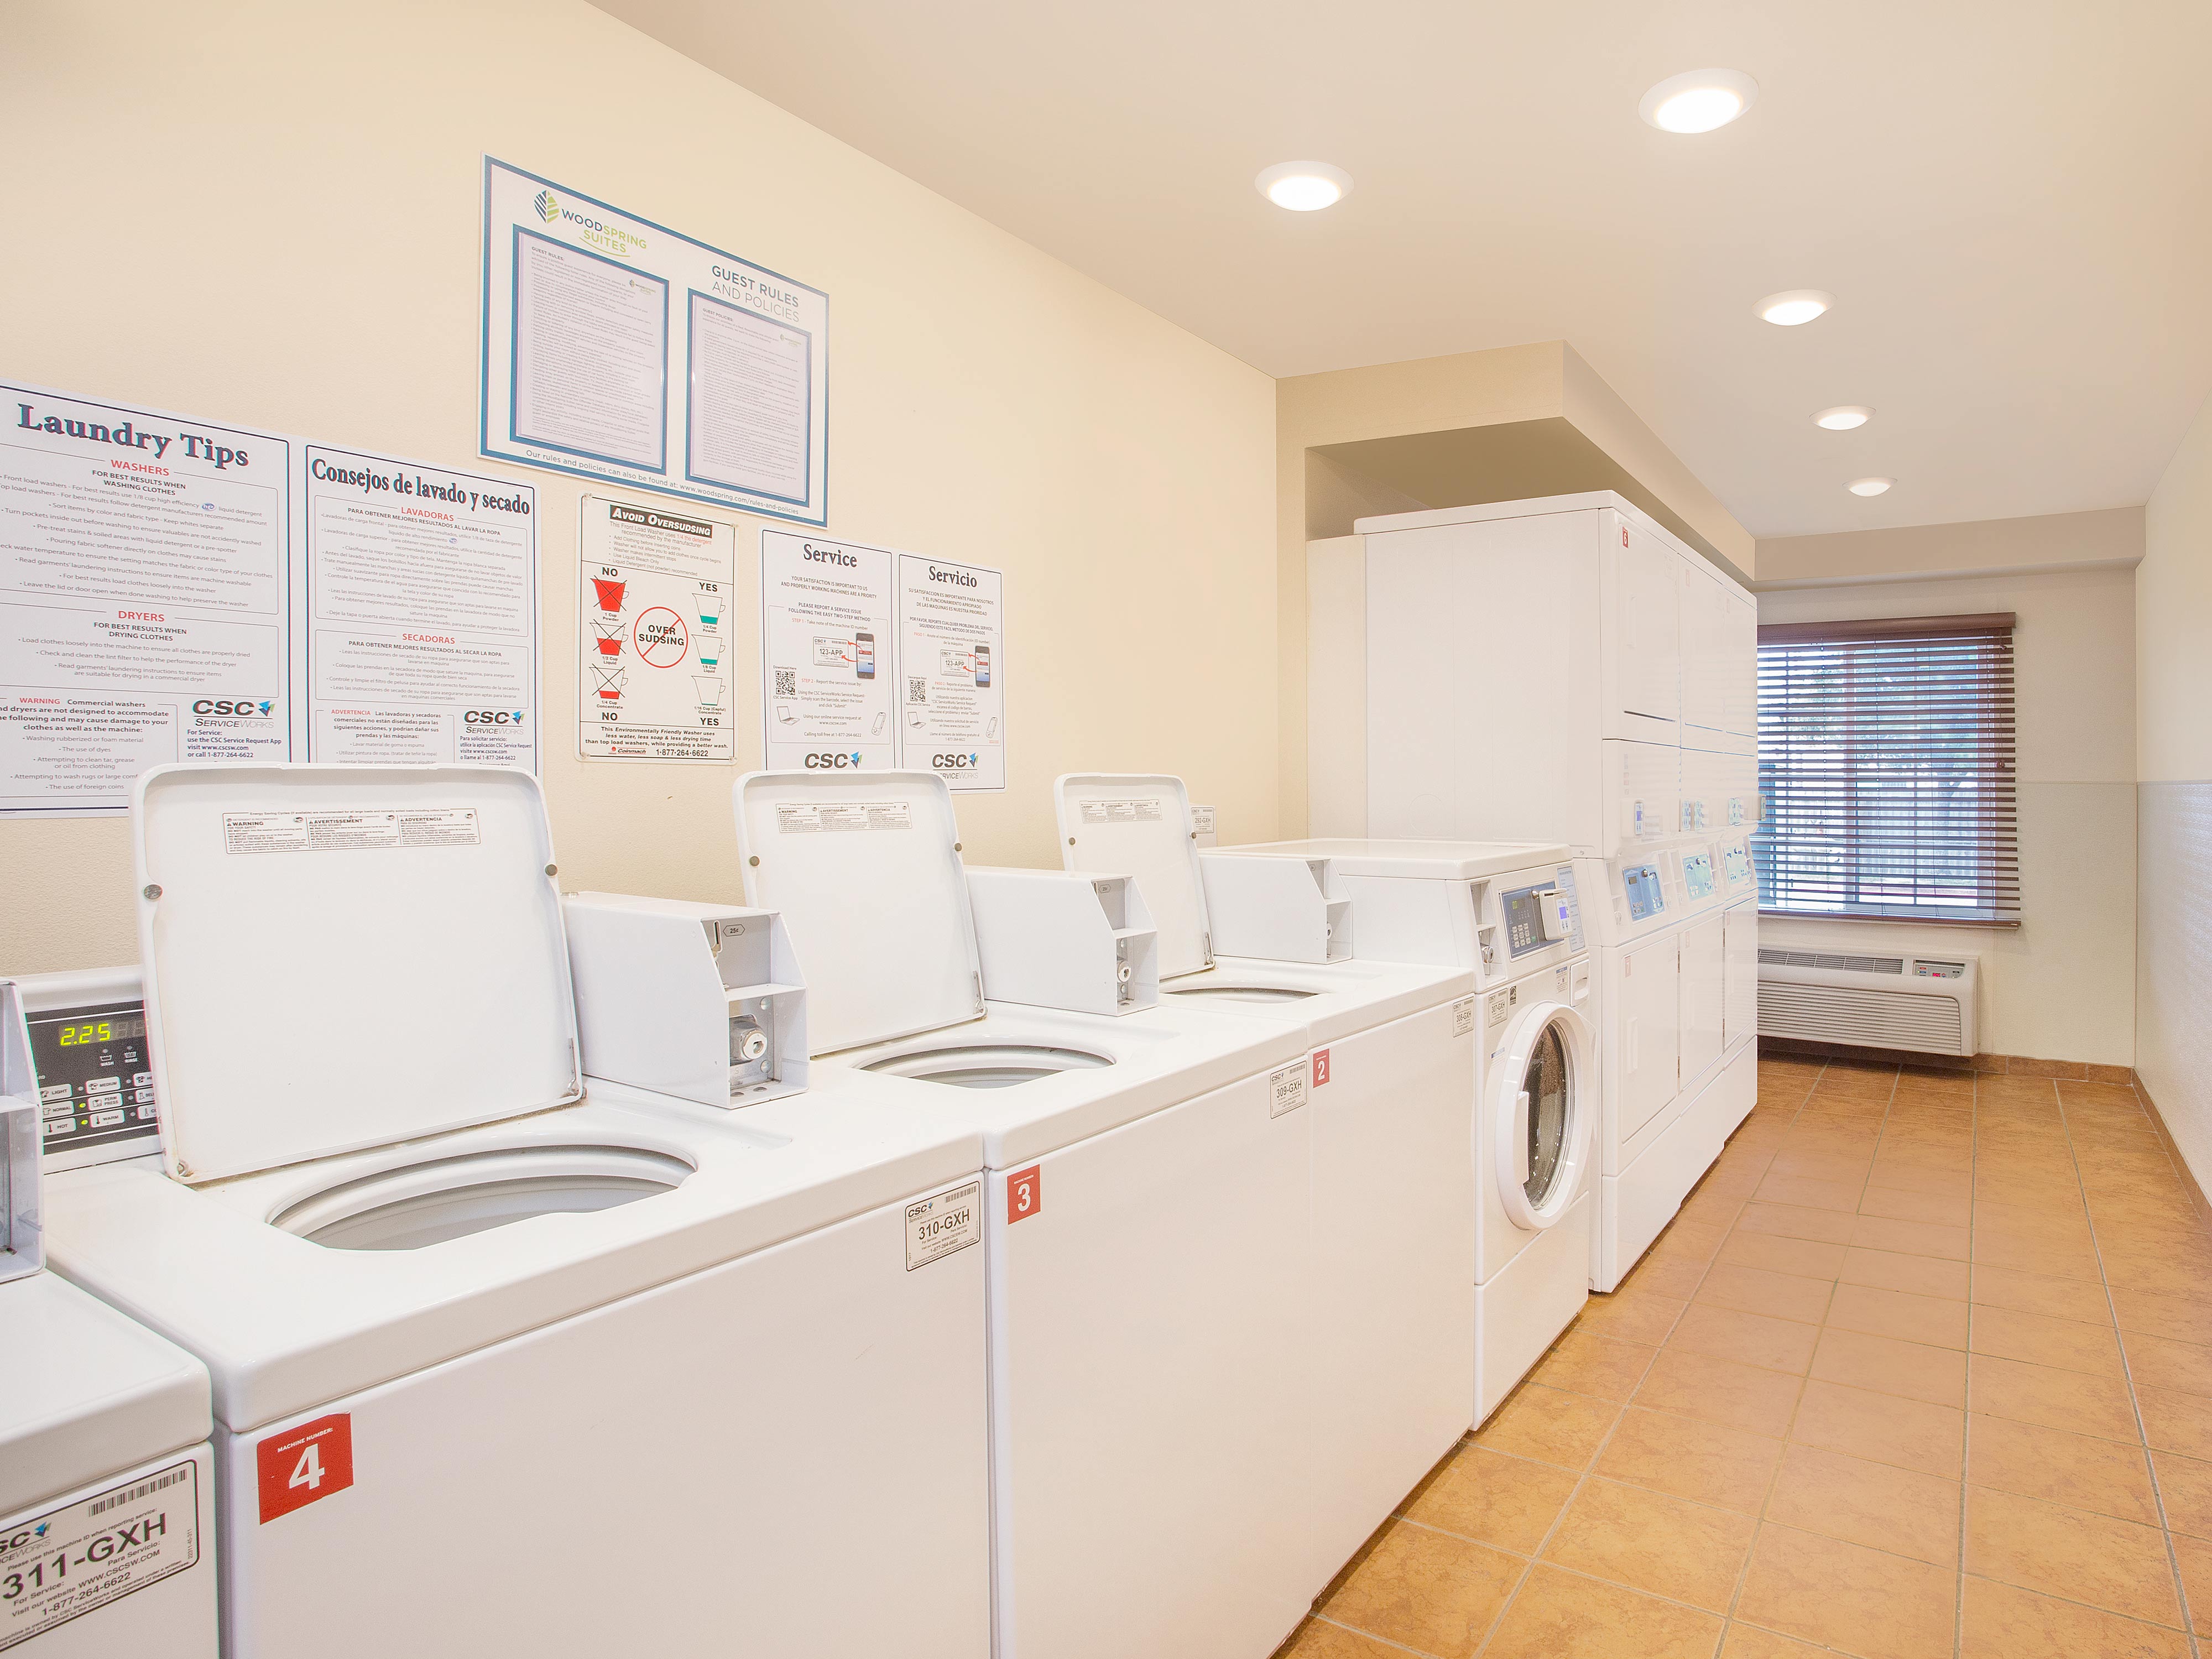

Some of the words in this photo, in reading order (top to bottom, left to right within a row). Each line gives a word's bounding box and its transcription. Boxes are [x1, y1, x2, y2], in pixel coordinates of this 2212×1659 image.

[561, 208, 647, 249] WOODSPRING
[583, 229, 627, 253] SUITES
[712, 265, 755, 290] GUEST
[759, 283, 799, 307] RULES
[712, 281, 741, 300] AND
[745, 293, 800, 322] POLICIES
[17, 403, 173, 459] Laundry
[180, 432, 250, 471] Tips
[110, 459, 170, 477] WASHERS
[526, 450, 541, 458] Our
[542, 455, 561, 463] rules
[579, 462, 606, 472] policies
[649, 477, 668, 486] found
[103, 480, 141, 490] WASHING
[142, 486, 175, 495] CLOTHES
[131, 476, 162, 486] RESULTS
[311, 458, 389, 494] Consejos
[393, 472, 413, 494] de
[416, 476, 467, 505] lavado
[469, 492, 479, 512] y
[482, 494, 531, 516] secado
[680, 484, 799, 515] www.woodspring.com/rules-and-policies
[400, 506, 455, 522] LAVADORAS
[612, 508, 645, 523] AVOID
[648, 514, 711, 536] OVERSUDSING
[802, 543, 857, 568] Service
[602, 566, 618, 577] NO
[928, 565, 978, 589] Servicio
[699, 582, 718, 592] YES
[118, 610, 165, 623] DRYERS
[402, 633, 456, 645] SECADORAS
[638, 633, 685, 646] SUDSING
[648, 624, 676, 635] OVER
[192, 699, 254, 717] CSC
[464, 710, 509, 725] CSC
[602, 712, 618, 721] NO
[195, 718, 274, 729] SERVICEWORKS
[700, 717, 719, 726] YES
[804, 753, 848, 769] CSC
[932, 754, 967, 769] CSC
[1318, 1060, 1325, 1081] 2
[1276, 1079, 1302, 1098] 309-GXH
[1017, 1183, 1031, 1212] 3
[908, 1204, 927, 1217] CSC
[919, 1208, 969, 1240] 310-GXH
[277, 1438, 305, 1453] MACHINE
[306, 1427, 333, 1441] NUMBER:
[289, 1443, 325, 1490] 4
[7, 1560, 29, 1571] Please
[56, 1538, 82, 1551] machine
[91, 1528, 107, 1537] when
[108, 1517, 134, 1530] reporting
[135, 1509, 157, 1520] service:
[2, 1512, 166, 1600] 311-GXH
[107, 1554, 126, 1567] Para
[127, 1541, 161, 1558] Servicio:
[47, 1587, 76, 1602] website
[78, 1549, 160, 1589] WWW.CSCSW.COM
[13, 1597, 29, 1606] For
[30, 1582, 65, 1600] Service:
[41, 1571, 132, 1616] 1-877-264-6622
